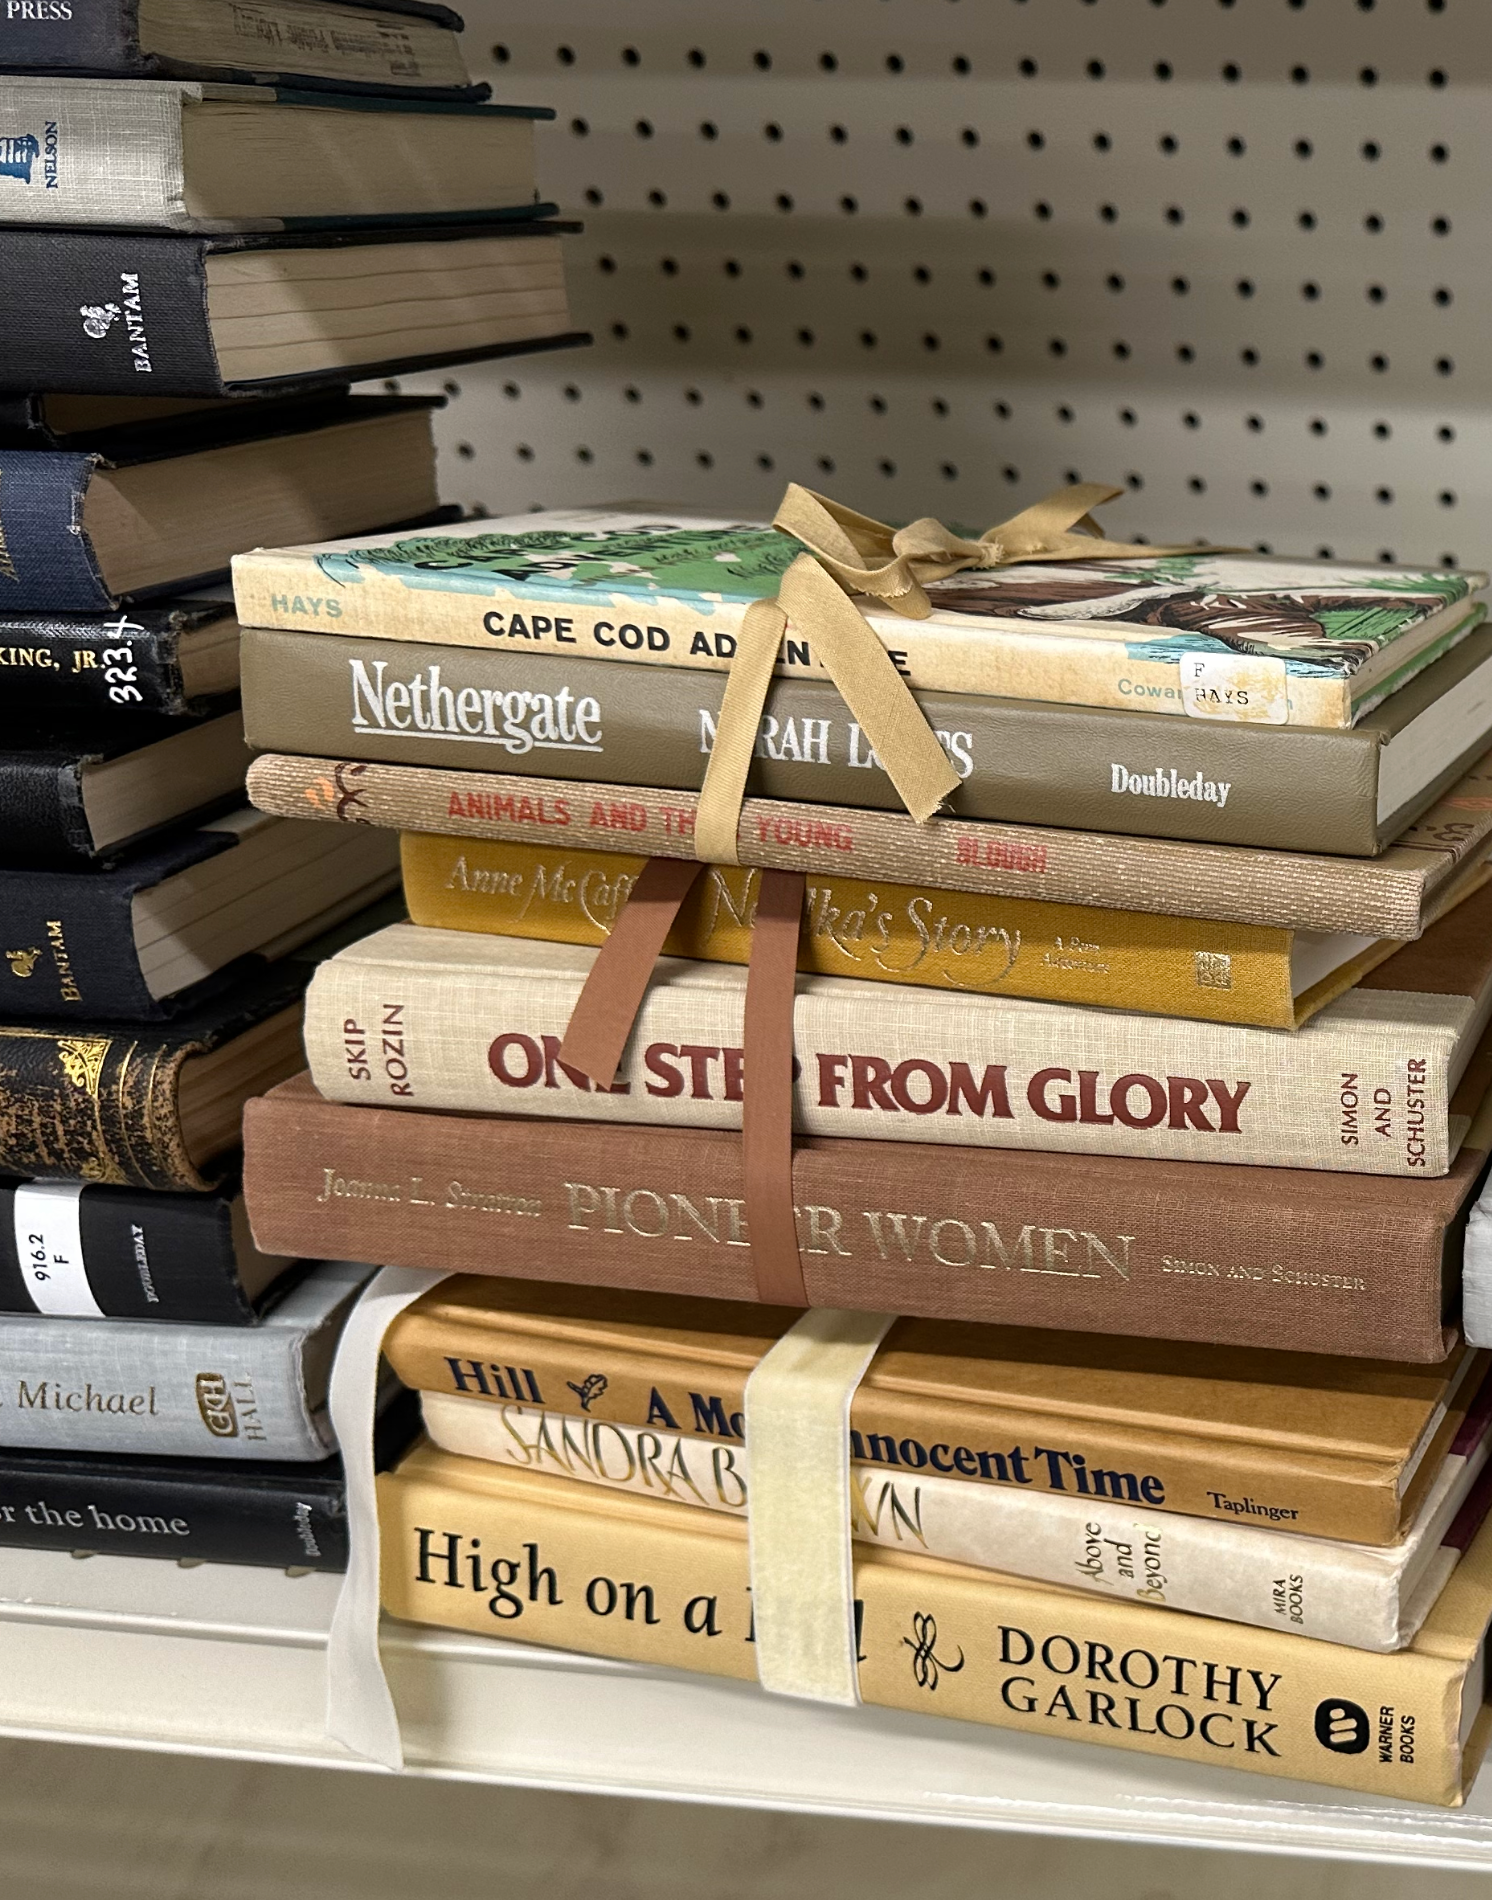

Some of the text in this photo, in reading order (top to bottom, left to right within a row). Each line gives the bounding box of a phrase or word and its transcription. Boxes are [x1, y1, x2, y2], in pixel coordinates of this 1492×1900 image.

[6, 1, 73, 20] PRESS
[45, 121, 58, 189] NELSON
[121, 272, 154, 374] BANTAM
[270, 594, 343, 619] HAYS
[483, 611, 671, 652] CAPE COD
[72, 649, 106, 673] JR.
[103, 615, 145, 703] 323.4
[1193, 662, 1206, 678] F
[348, 659, 603, 754] Nethergate
[699, 709, 832, 764] NRAH
[447, 791, 571, 826] ANIMALS
[589, 801, 647, 832] AND
[1110, 763, 1233, 808] Doubleday
[754, 814, 855, 852] YOUNG
[445, 855, 523, 897] Anne
[46, 920, 83, 1001] BANTAM
[876, 896, 1021, 987] Story
[343, 1018, 371, 1081] SKIP
[381, 1004, 415, 1097] ROZIN
[488, 1033, 1251, 1134] ON STE FROM GLORY
[1341, 1072, 1359, 1146] SIMON
[1374, 1087, 1392, 1138] AND
[1406, 1058, 1428, 1167] SCHUSTER
[28, 1233, 51, 1281] 916.2
[54, 1254, 70, 1265] F
[564, 1182, 853, 1257] PIONER
[860, 1211, 1136, 1282] WOMEN
[18, 1380, 159, 1416] Michael
[233, 1371, 268, 1441] HALL
[443, 1356, 546, 1405] Hill
[645, 1386, 677, 1430] A
[850, 1428, 1032, 1483] nnocent
[1034, 1446, 1166, 1505] Time
[500, 1404, 929, 1549] SANDRA BWN
[25, 1501, 84, 1528] the
[88, 1504, 190, 1536] home
[1206, 1490, 1299, 1521] Taplinger
[1075, 1521, 1114, 1586] Above
[1104, 1538, 1135, 1579] and
[1133, 1522, 1168, 1603] Beyond
[413, 1527, 563, 1619] High
[584, 1575, 661, 1625] on
[683, 1595, 722, 1637] a
[1272, 1578, 1287, 1616] MIRA
[1289, 1574, 1304, 1625] BOOKS
[997, 1625, 1282, 1711] DOROTHY
[999, 1676, 1282, 1758] GARLOCK
[1378, 1705, 1394, 1763] WARNER
[1399, 1715, 1415, 1764] BOOKS
